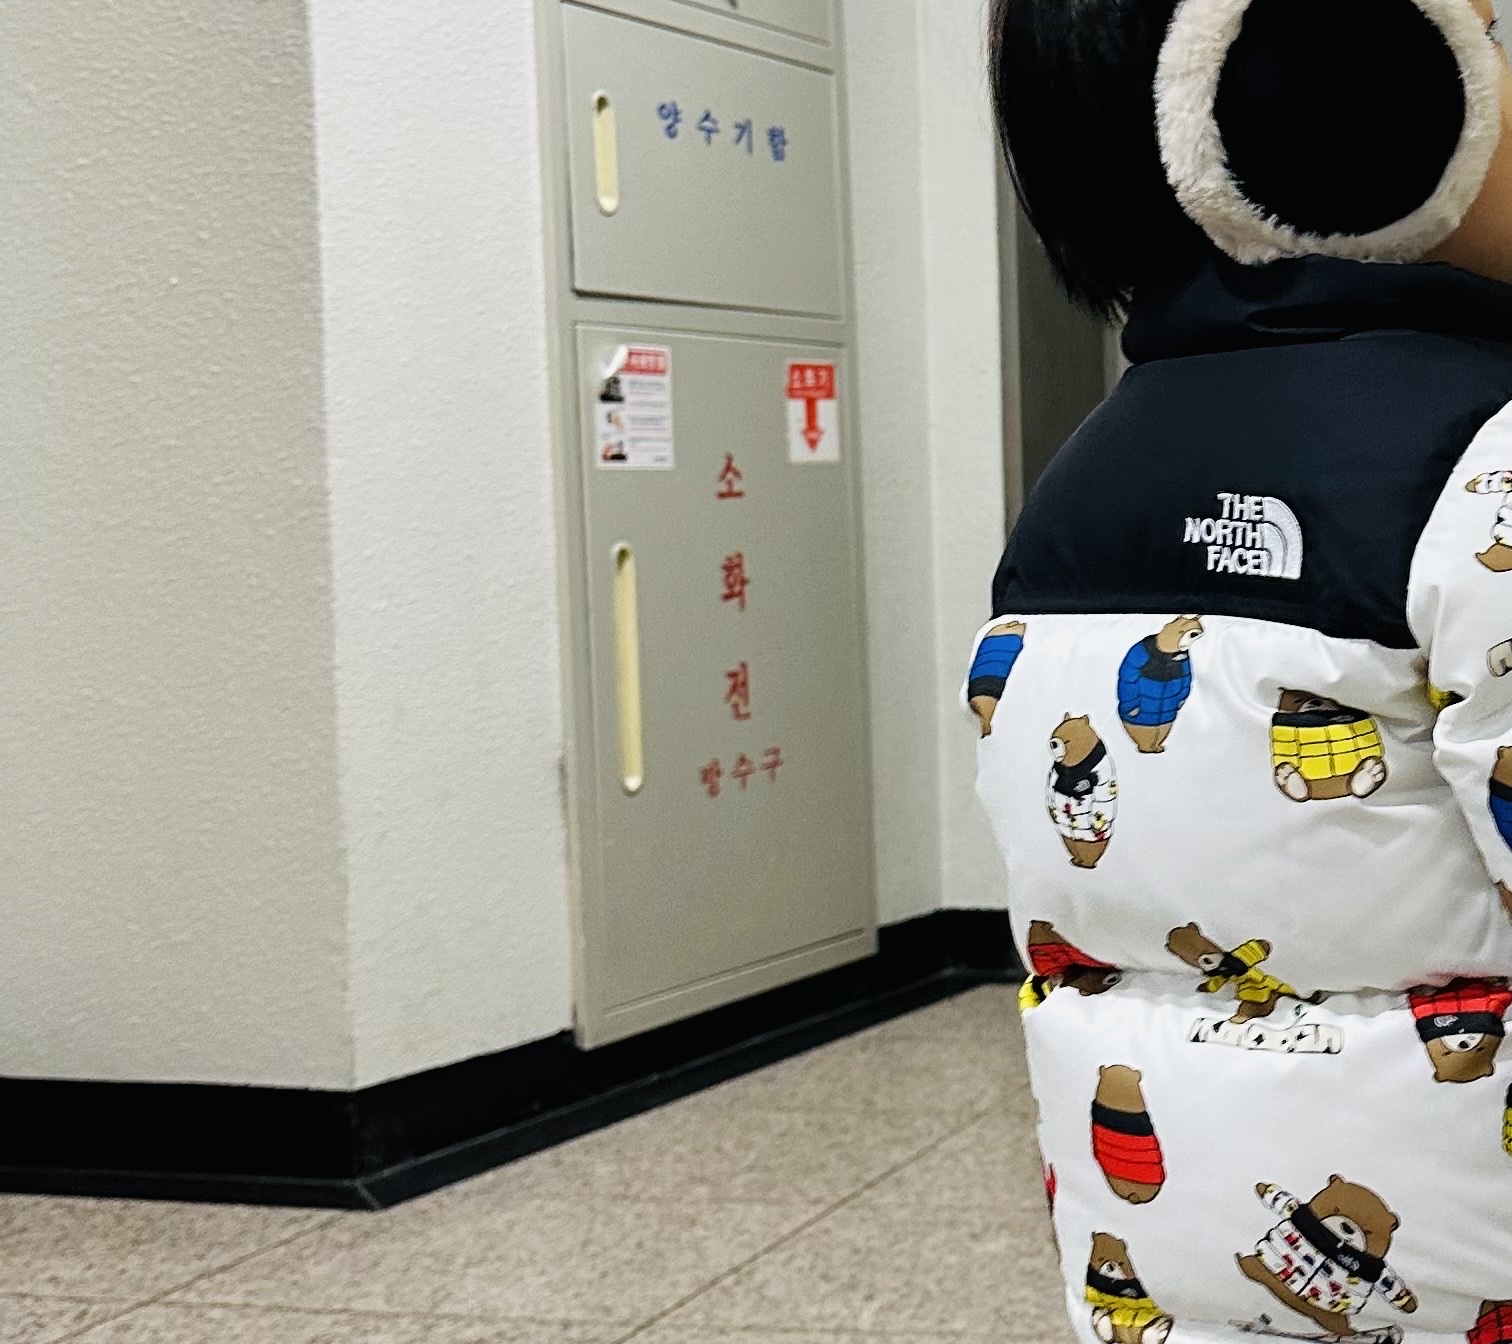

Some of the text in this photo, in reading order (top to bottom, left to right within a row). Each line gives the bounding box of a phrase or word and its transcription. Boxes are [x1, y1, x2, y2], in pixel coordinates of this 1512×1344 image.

[1216, 492, 1263, 521] THE
[1183, 516, 1263, 549] NORTH
[1206, 545, 1264, 576] FACE
